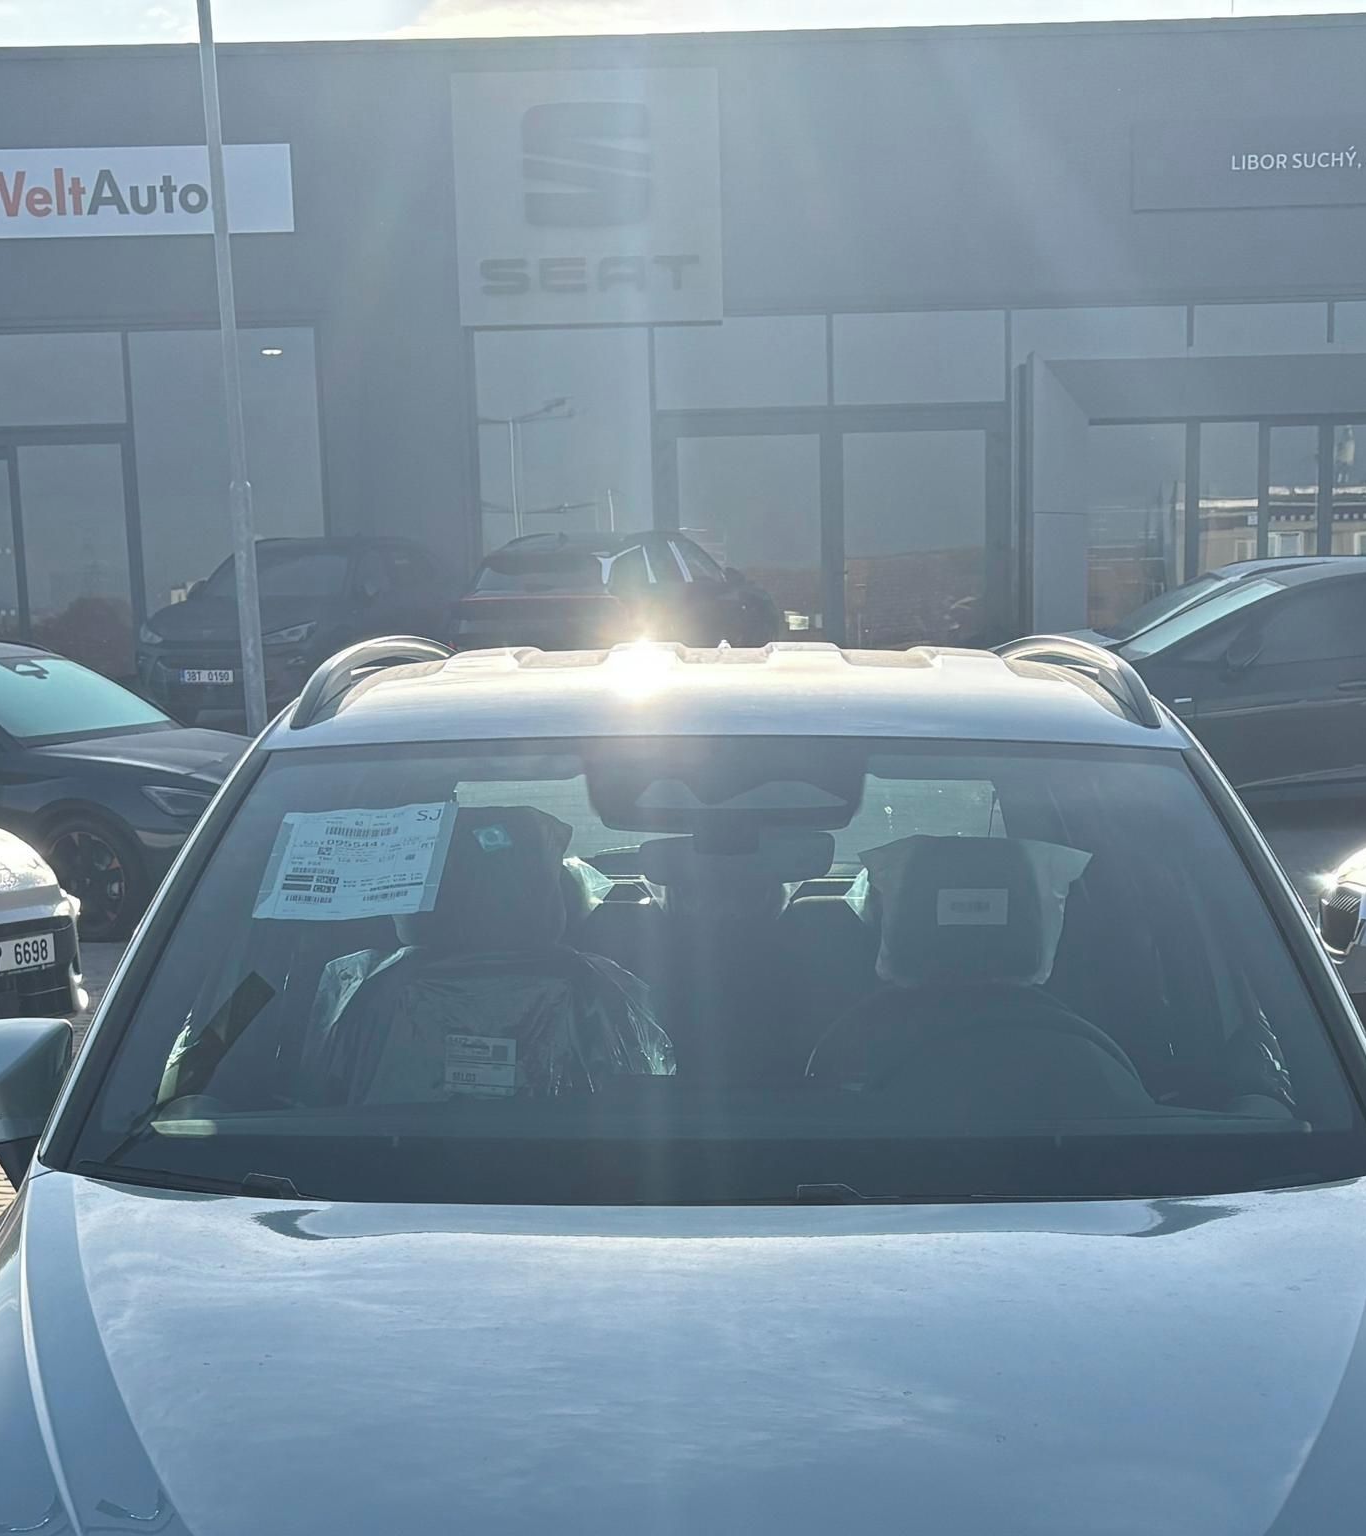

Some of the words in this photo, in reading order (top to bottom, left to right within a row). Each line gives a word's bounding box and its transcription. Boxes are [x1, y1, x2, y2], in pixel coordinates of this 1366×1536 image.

[1231, 152, 1288, 171] LIBOR
[1291, 145, 1363, 170] SUCHÝ,
[479, 254, 700, 297] SEAT
[14, 938, 48, 965] 6698
